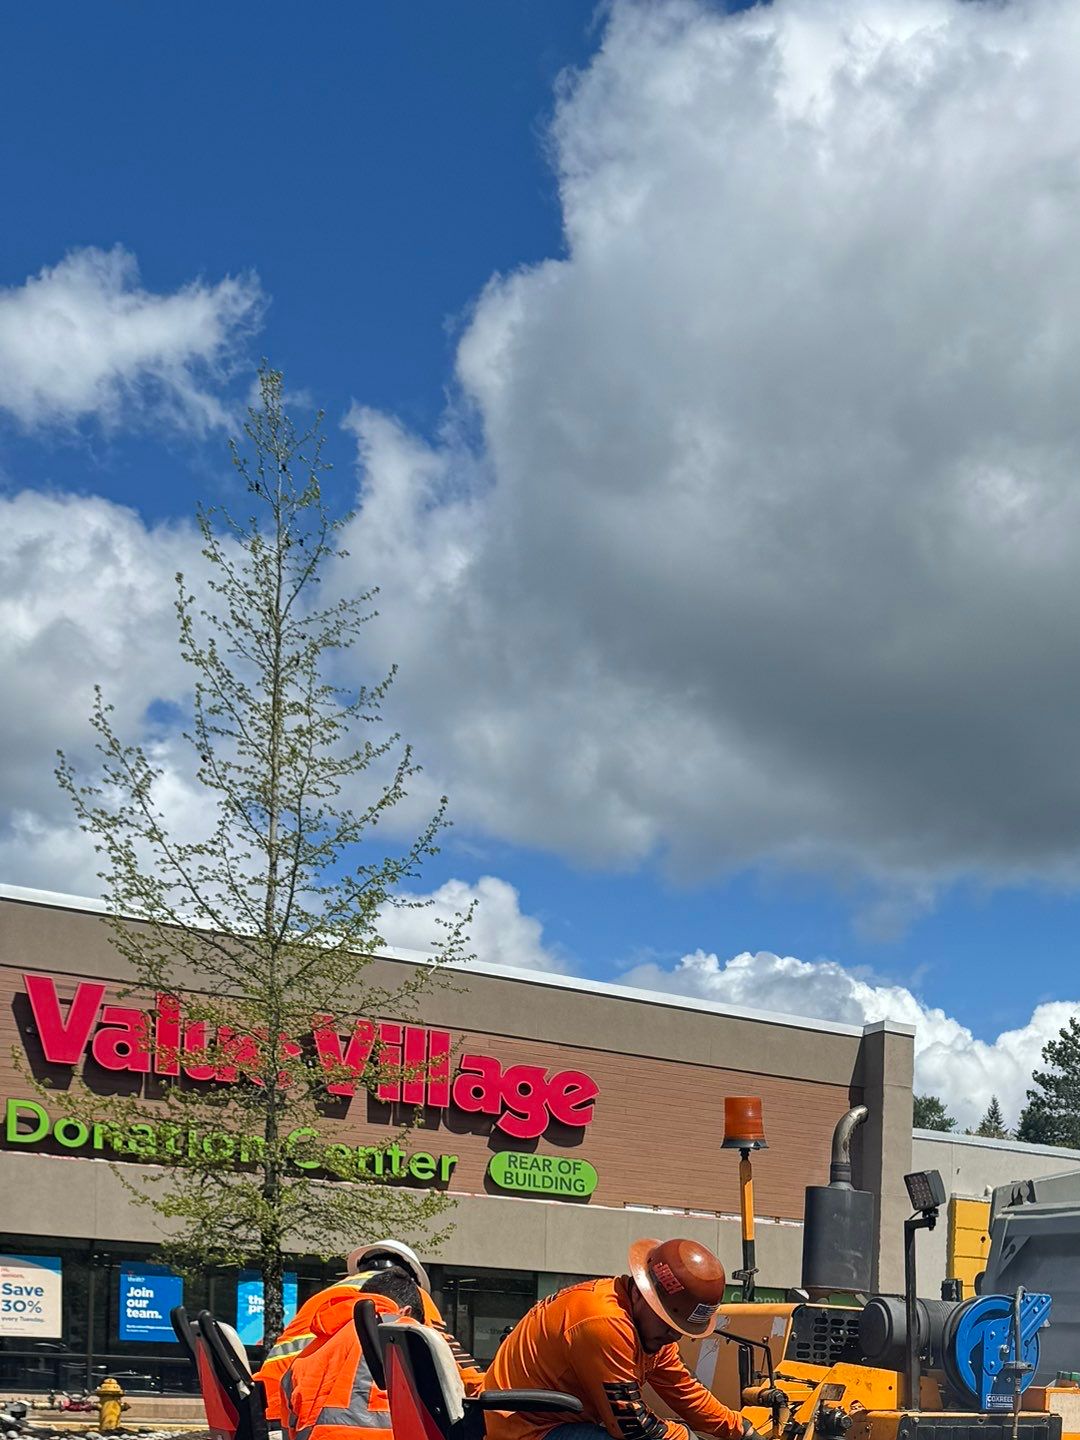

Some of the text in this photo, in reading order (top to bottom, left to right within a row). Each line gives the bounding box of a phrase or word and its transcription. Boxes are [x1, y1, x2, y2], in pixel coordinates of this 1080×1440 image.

[311, 1014, 600, 1138] Village
[287, 1127, 459, 1181] Center
[508, 1154, 582, 1175] REAR OF
[504, 1171, 585, 1193] BUILDING
[2, 1282, 45, 1297] Save
[126, 1287, 154, 1298] Join
[1, 1299, 42, 1313] 30%
[126, 1299, 149, 1308] our
[126, 1308, 163, 1319] team.
